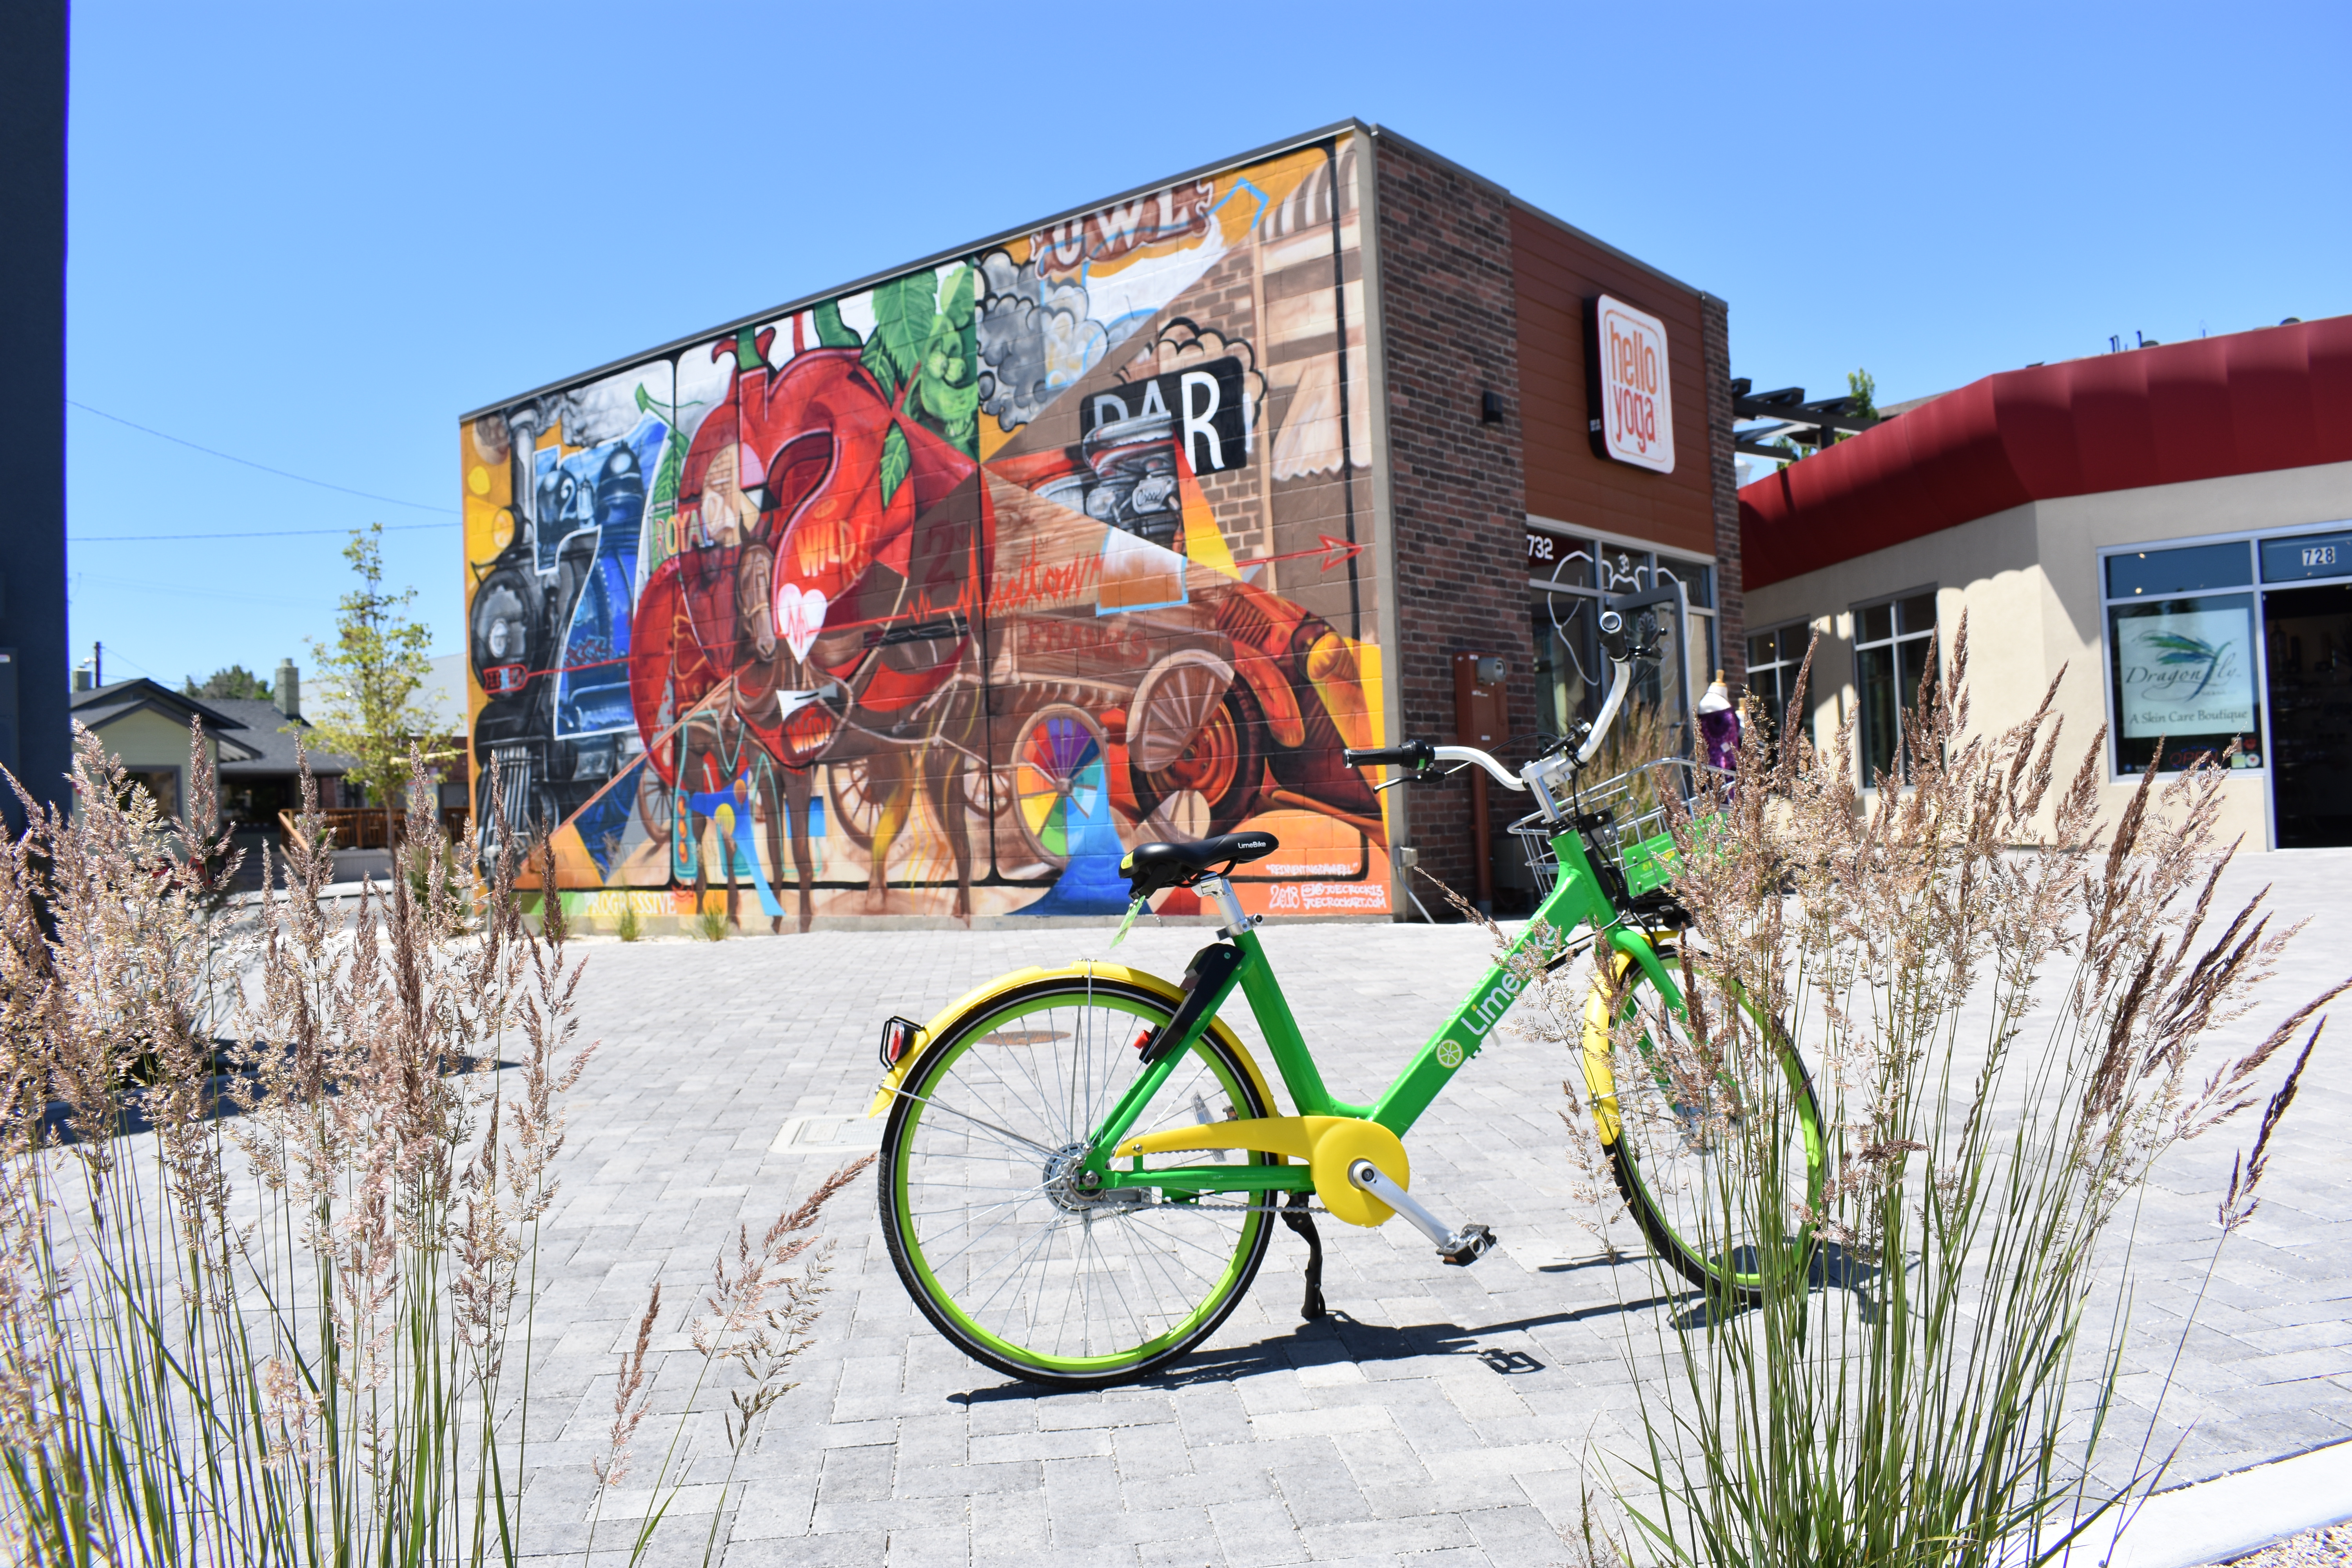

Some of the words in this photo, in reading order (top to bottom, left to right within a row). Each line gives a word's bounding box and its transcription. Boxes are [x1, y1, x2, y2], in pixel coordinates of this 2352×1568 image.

[1610, 320, 1657, 395] hello
[1613, 384, 1656, 453] yoga
[1526, 534, 1553, 560] 732
[2304, 548, 2334, 564] 728
[2129, 713, 2139, 725] A
[2141, 711, 2166, 724] Skin
[2169, 711, 2194, 722] Care
[2198, 709, 2247, 722] Boutique
[583, 892, 677, 914] PROGRESSIVE
[1269, 885, 1300, 909] 2018
